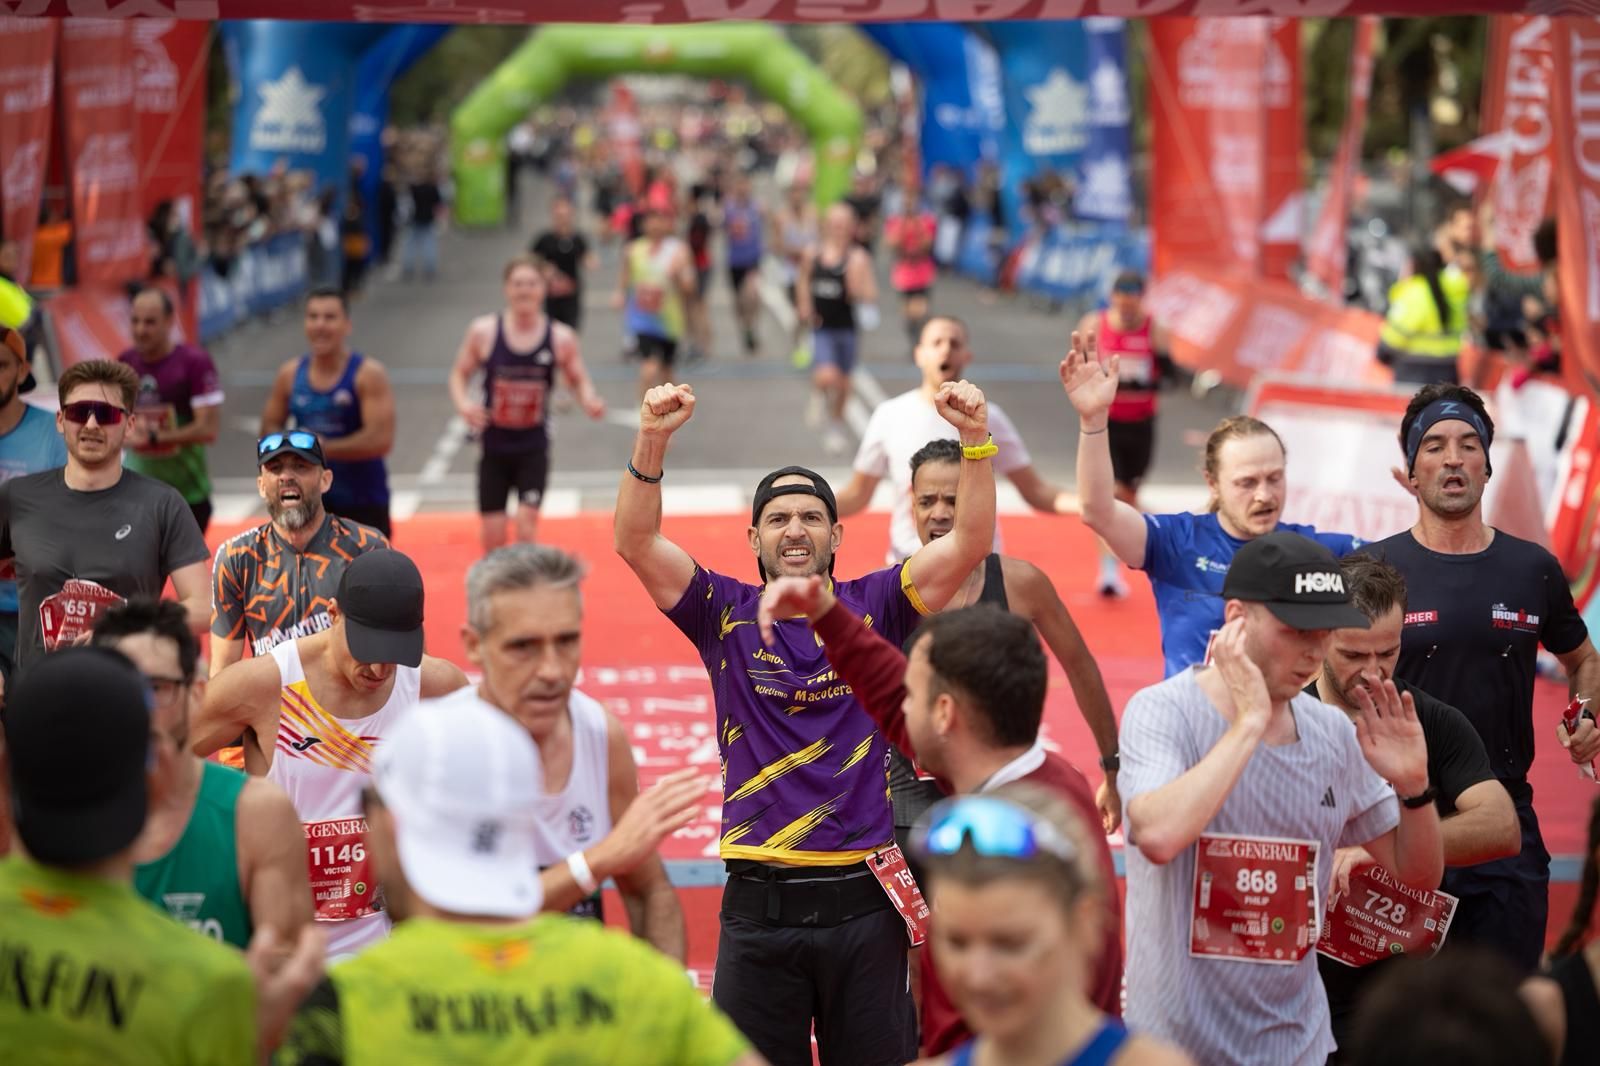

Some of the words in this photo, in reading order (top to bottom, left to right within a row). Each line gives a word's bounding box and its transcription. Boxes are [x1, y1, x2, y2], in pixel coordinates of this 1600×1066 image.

[1294, 571, 1345, 594] HOKA
[66, 616, 84, 625] PETER
[754, 684, 788, 699] Atletismo
[794, 684, 853, 702] Macotera
[310, 843, 365, 865] 1146
[1233, 841, 1299, 862] GENERALI
[323, 866, 351, 875] VICTOR
[1236, 868, 1277, 893] 868
[1364, 888, 1407, 925] 728
[1345, 904, 1374, 924] SERGIO
[1373, 918, 1413, 939] MORENTE
